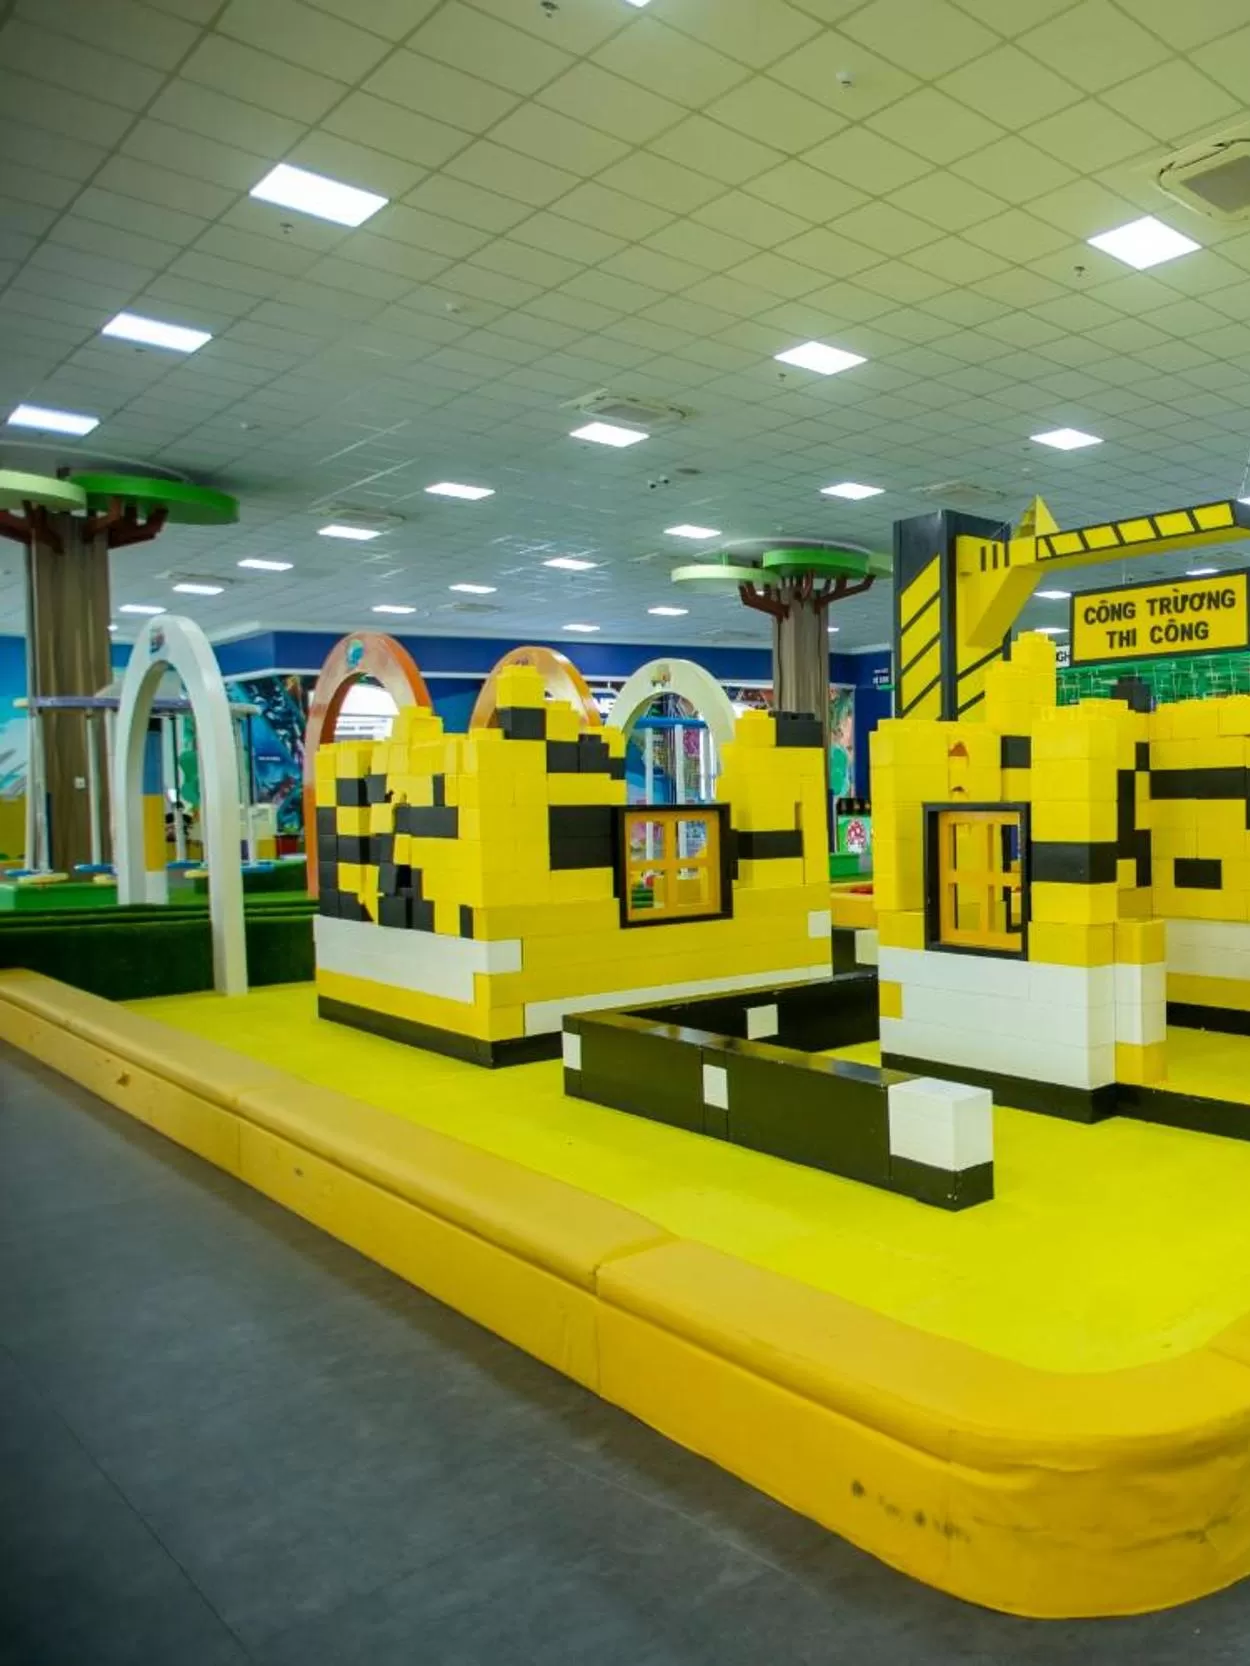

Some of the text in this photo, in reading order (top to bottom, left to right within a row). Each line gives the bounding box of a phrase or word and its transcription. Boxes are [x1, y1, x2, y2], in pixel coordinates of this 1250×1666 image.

[1083, 600, 1136, 625] CÔNG
[1106, 618, 1209, 649] THI CÔNG
